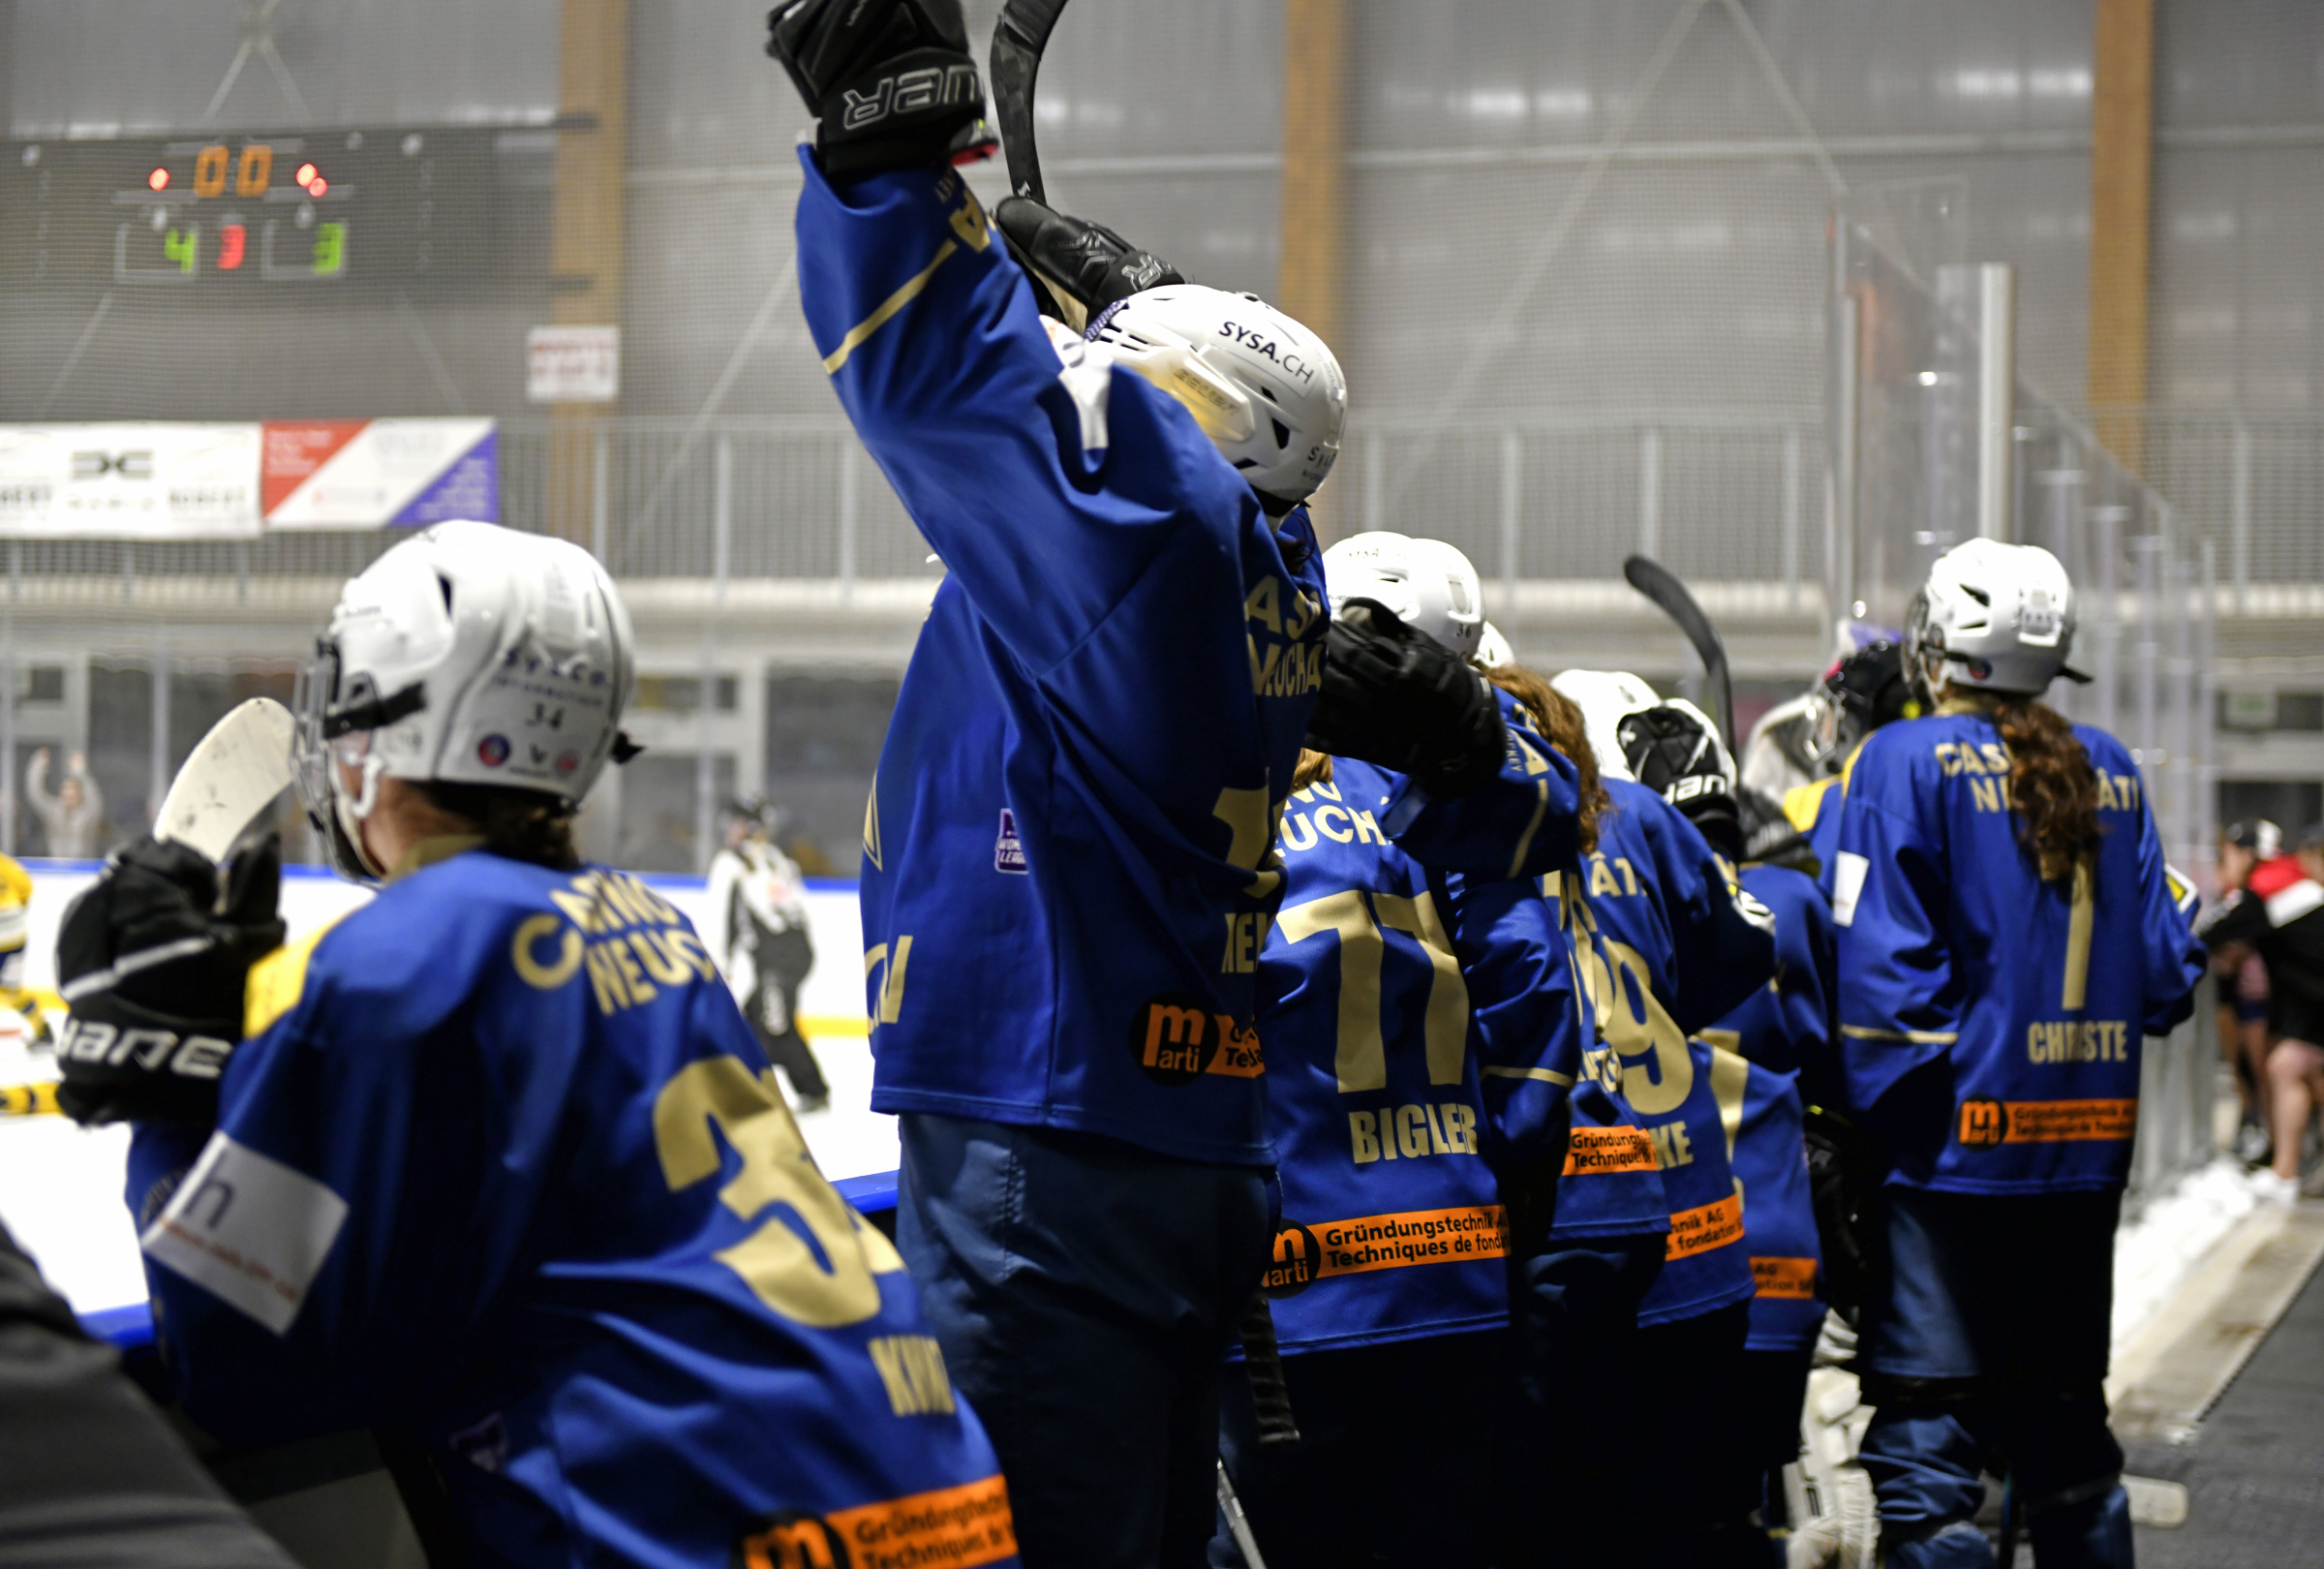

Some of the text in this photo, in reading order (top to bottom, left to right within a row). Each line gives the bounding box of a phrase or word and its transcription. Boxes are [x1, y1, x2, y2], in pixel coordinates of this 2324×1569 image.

[164, 228, 197, 274] 4
[1218, 322, 1315, 385] SYSA.CH
[1276, 888, 1470, 1094] 77
[1143, 1003, 1207, 1073] marti
[1349, 1102, 1479, 1164] BIGLER
[1326, 1215, 1495, 1246] Gründungstechnik
[1706, 1207, 1726, 1224] AG
[1327, 1241, 1450, 1269] Techniques
[1453, 1234, 1473, 1254] de
